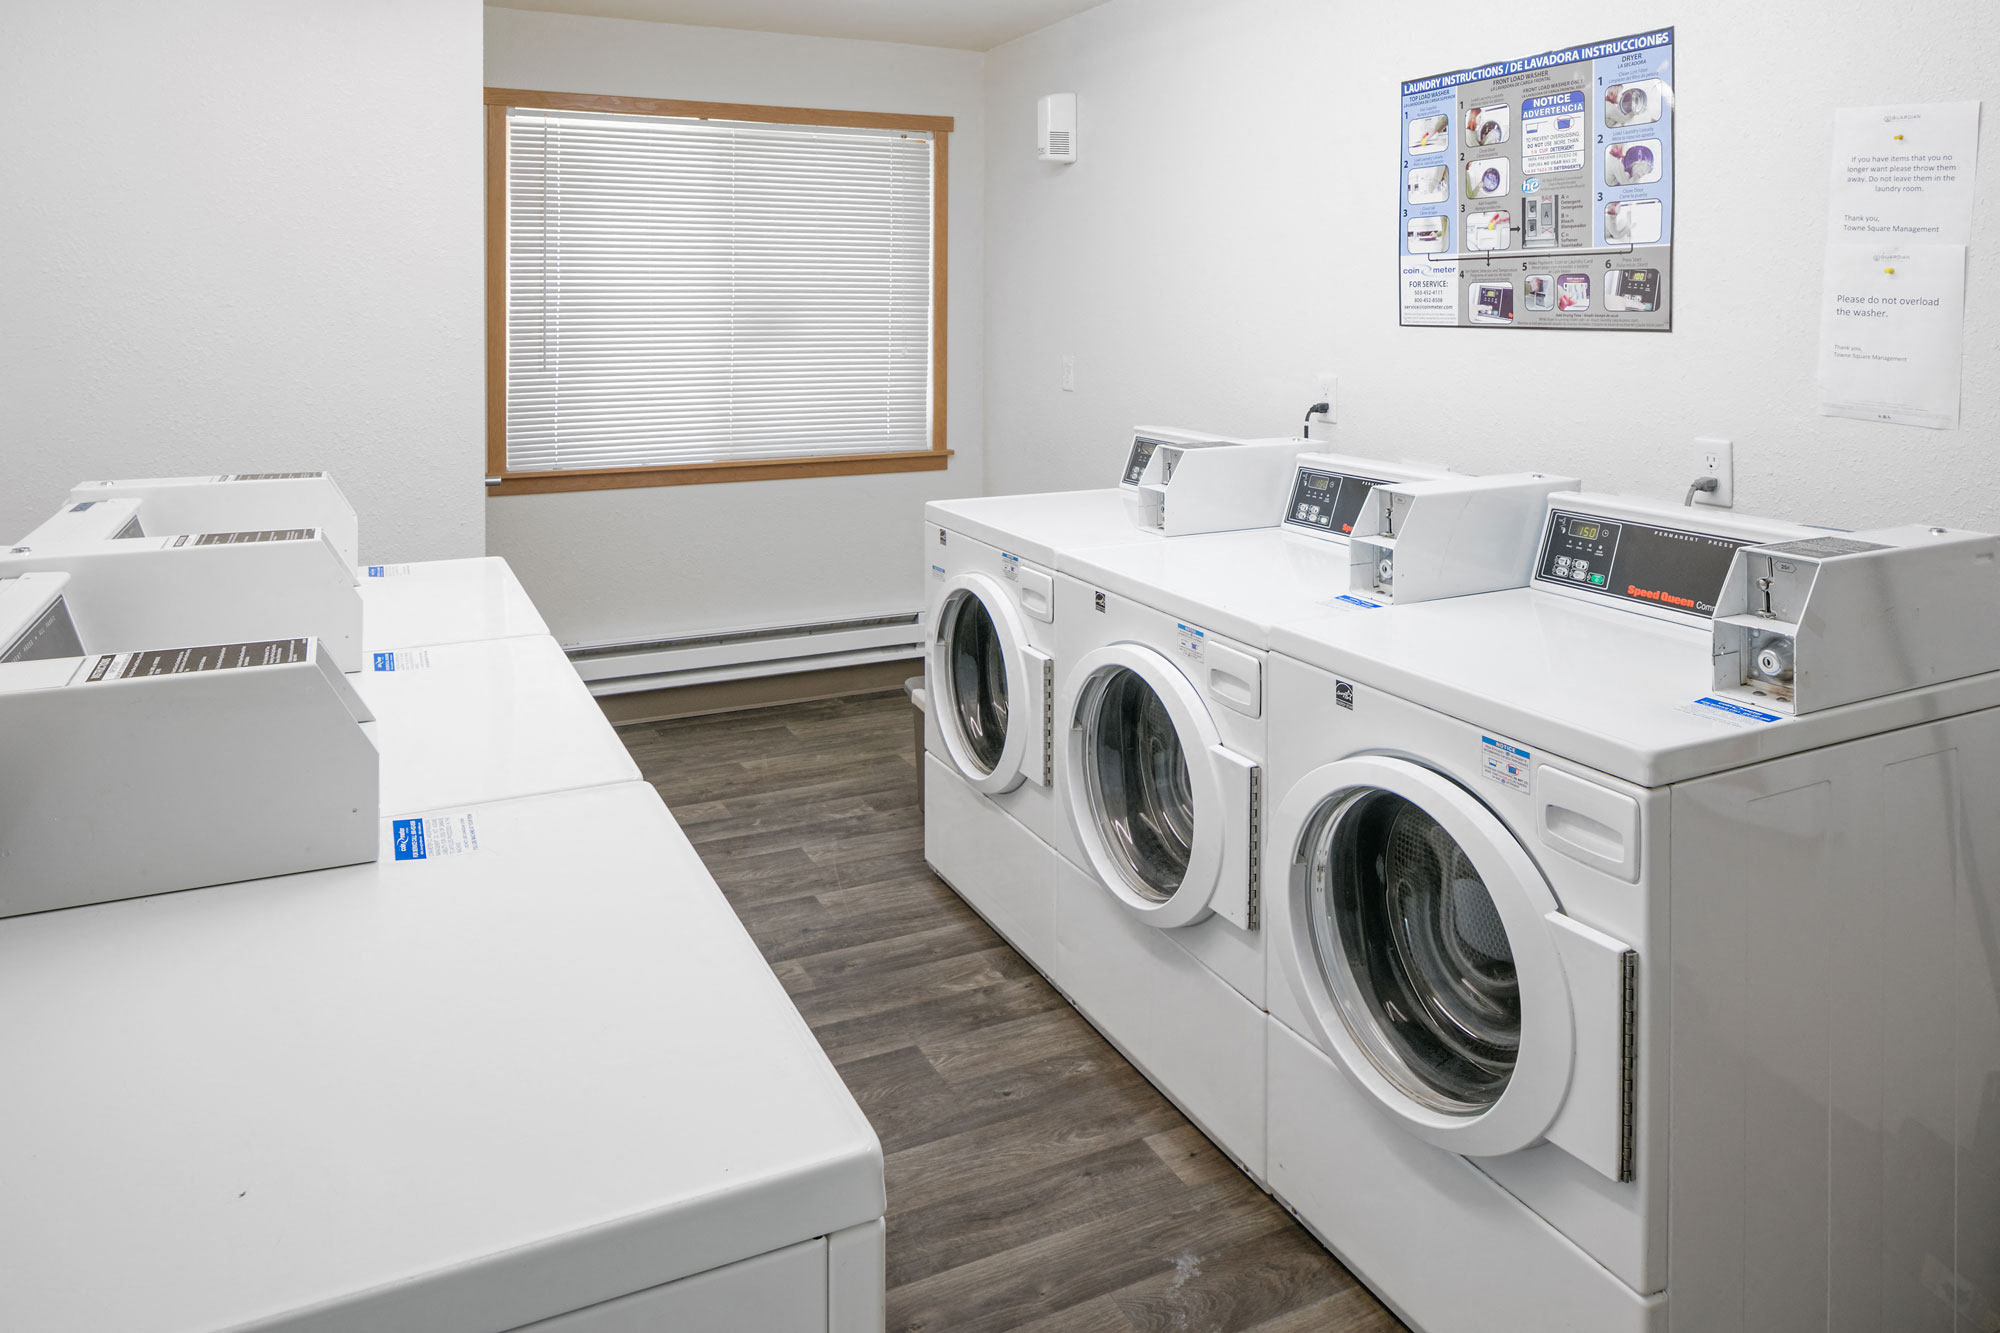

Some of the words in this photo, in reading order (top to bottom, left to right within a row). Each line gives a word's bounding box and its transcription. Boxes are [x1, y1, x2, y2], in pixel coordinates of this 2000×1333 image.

[1621, 53, 1642, 62] DRYER
[1404, 78, 1441, 94] LAUNDRY
[1442, 65, 1504, 87] INSTRUCTIONS
[1510, 61, 1523, 73] DE
[1524, 51, 1580, 70] LAVADORA
[1582, 32, 1669, 59] INSTRUCCIONES
[1624, 59, 1646, 68] SECADORA
[1493, 77, 1509, 86] FRONT
[1510, 74, 1525, 83] LOAD
[1525, 70, 1549, 80] WASHER
[1598, 76, 1603, 86] 1
[1551, 80, 1570, 88] WASHER
[1419, 93, 1430, 101] LOAD
[1431, 89, 1450, 98] WASHER
[1460, 101, 1464, 109] 1
[1533, 93, 1571, 108] NOTICE
[1405, 111, 1408, 119] 1
[1523, 103, 1583, 119] ADVERTENCIA
[1597, 134, 1603, 144] 2
[1550, 144, 1575, 152] DETERGENT
[1460, 152, 1465, 161] 2
[1872, 155, 1889, 163] have
[1404, 160, 1409, 168] 2
[1889, 165, 1912, 173] please
[1913, 174, 1932, 182] them
[1597, 192, 1603, 201] 3
[1460, 204, 1466, 212] 3
[1403, 209, 1408, 217] 3
[1867, 224, 1891, 232] Square
[1892, 225, 1940, 233] Management
[1522, 261, 1527, 271] 5
[1605, 259, 1611, 268] 6
[1460, 270, 1465, 279] 4
[1837, 294, 1865, 304] Please
[1867, 295, 1879, 304] do
[1881, 297, 1897, 305] not
[1899, 297, 1940, 306] overload
[1836, 307, 1851, 316] the
[1853, 308, 1888, 318] washer.
[1872, 354, 1907, 362] Management
[1579, 526, 1597, 538] 150
[1654, 530, 1699, 542] PERMANENT
[1707, 540, 1734, 549] PRESS
[1627, 584, 1660, 600] Speed
[1660, 591, 1695, 608] Queen
[1495, 740, 1516, 754] NOTICE
